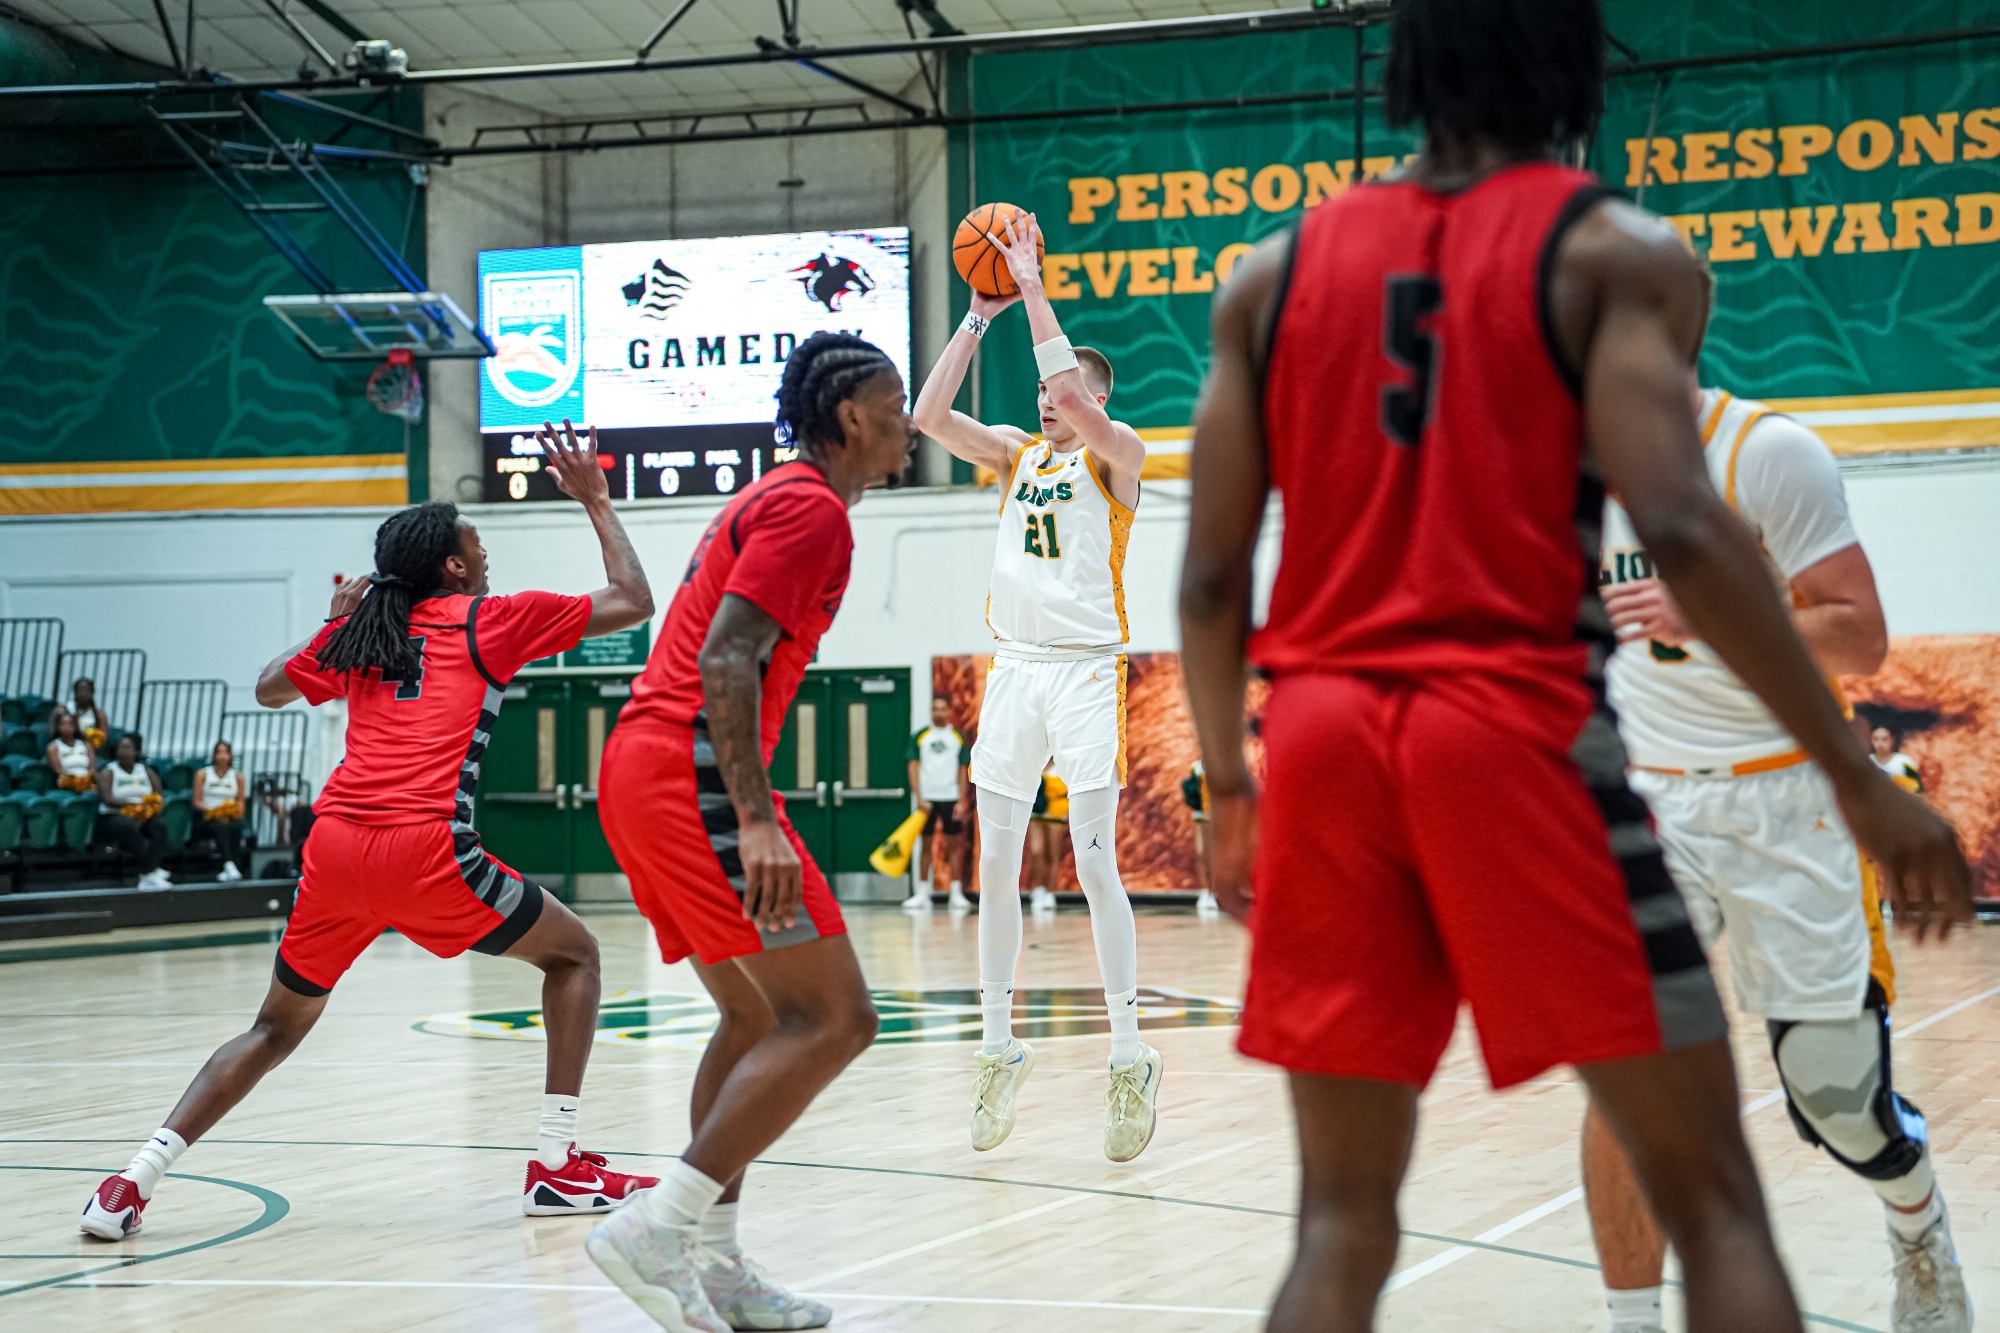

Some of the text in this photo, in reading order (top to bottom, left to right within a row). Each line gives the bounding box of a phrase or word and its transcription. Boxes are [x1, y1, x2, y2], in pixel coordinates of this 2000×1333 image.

[1625, 107, 2000, 187] RESPONS
[627, 329, 863, 371] GAMED
[1380, 274, 1445, 447] 5
[508, 472, 528, 500] 0
[660, 467, 680, 495] 0
[715, 465, 735, 493] 0
[1024, 512, 1062, 559] 21
